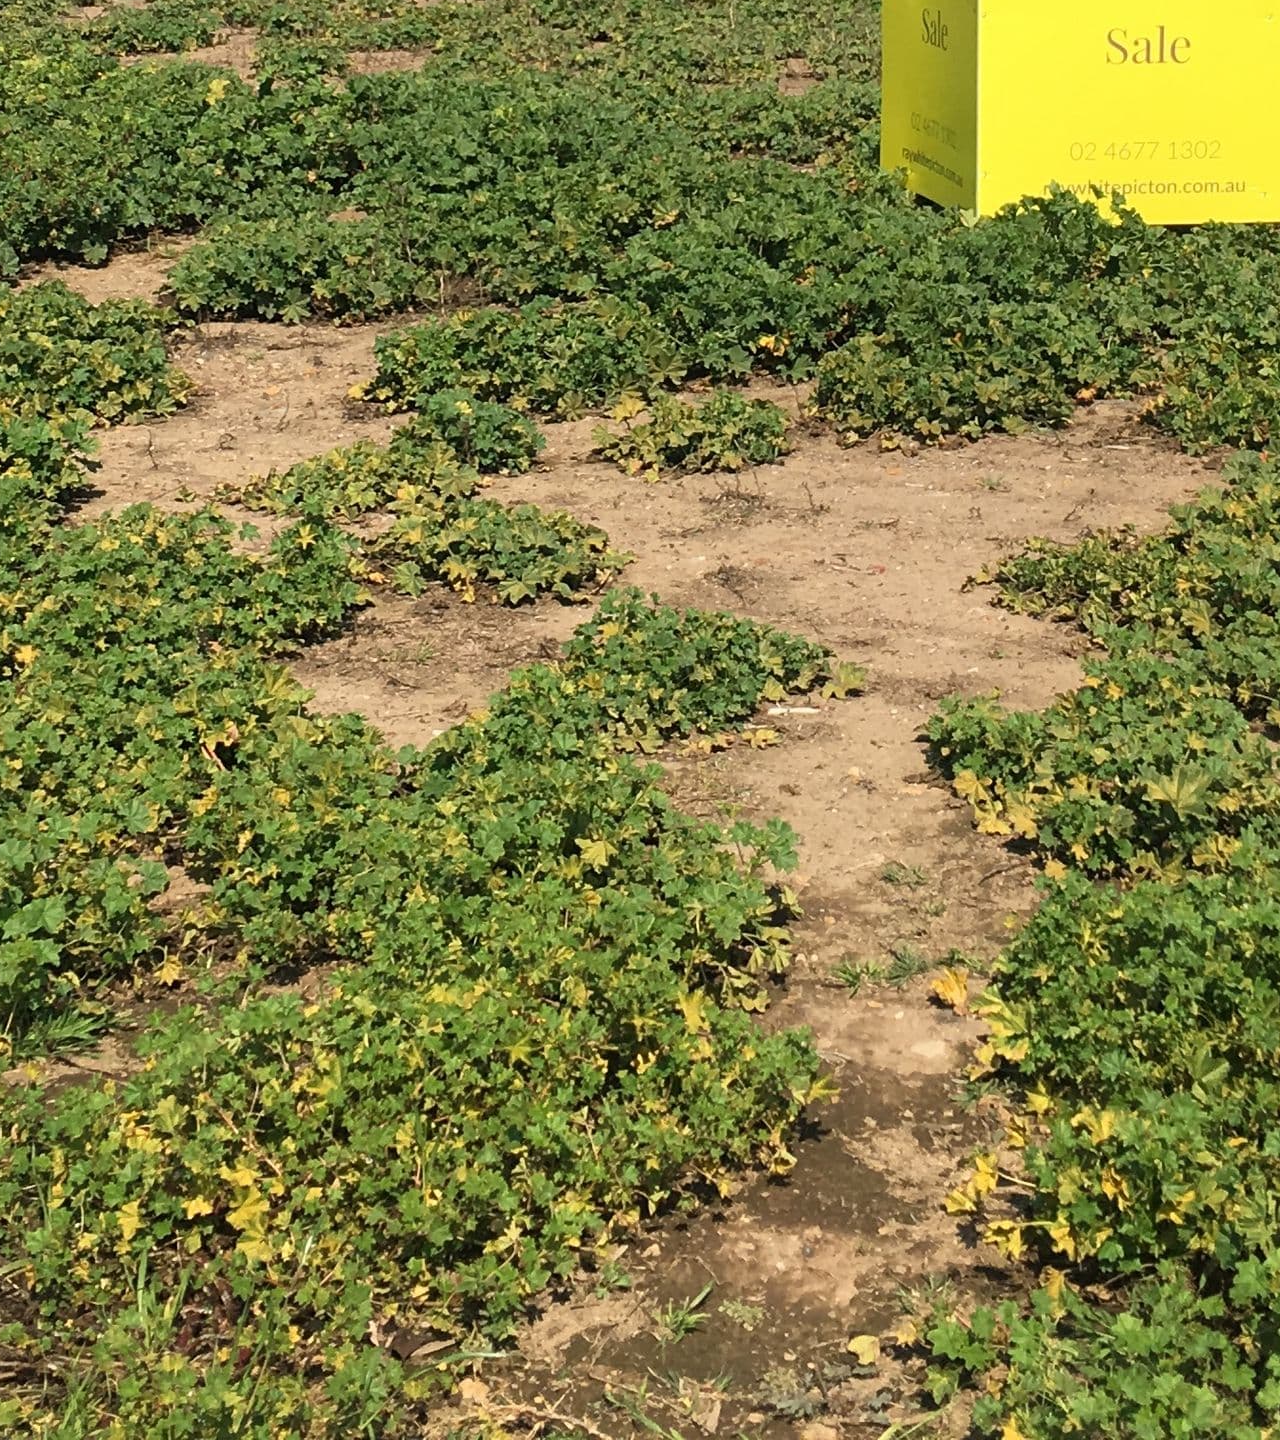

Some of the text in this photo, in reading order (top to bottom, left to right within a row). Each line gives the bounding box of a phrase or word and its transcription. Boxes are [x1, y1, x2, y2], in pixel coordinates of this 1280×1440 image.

[921, 9, 948, 51] Sale
[1106, 25, 1191, 64] Sale
[1070, 140, 1222, 161] 02 4677 1302
[1043, 178, 1246, 198] rywhitepicton.com.au
